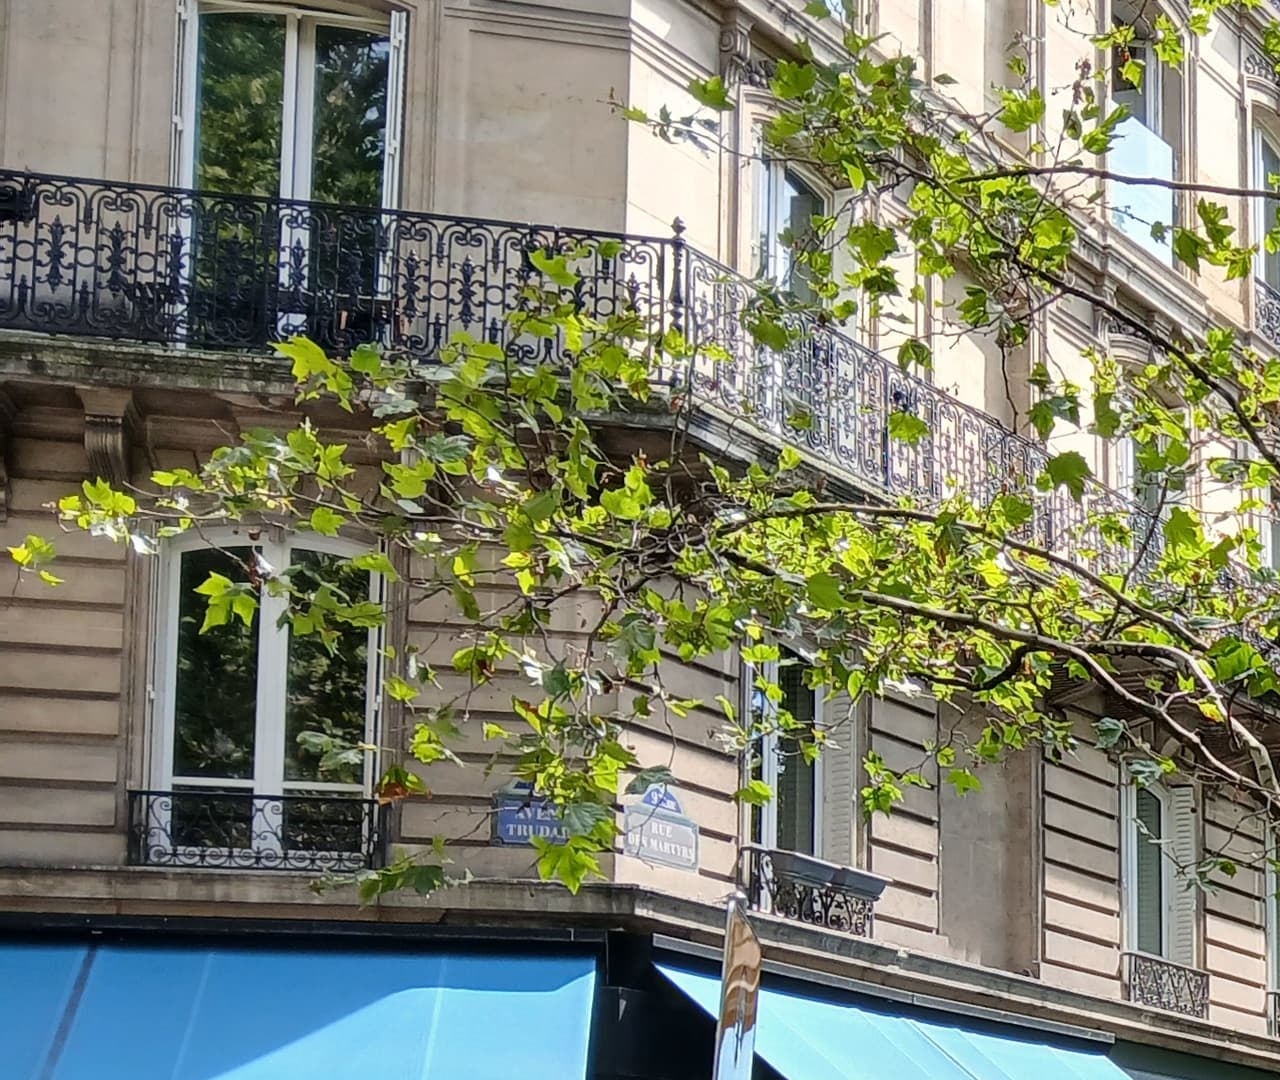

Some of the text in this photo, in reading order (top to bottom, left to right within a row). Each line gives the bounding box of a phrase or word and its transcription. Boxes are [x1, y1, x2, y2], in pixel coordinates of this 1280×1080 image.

[514, 807, 560, 821] AVEN
[651, 821, 673, 838] RUE
[650, 838, 693, 858] MARTYRS
